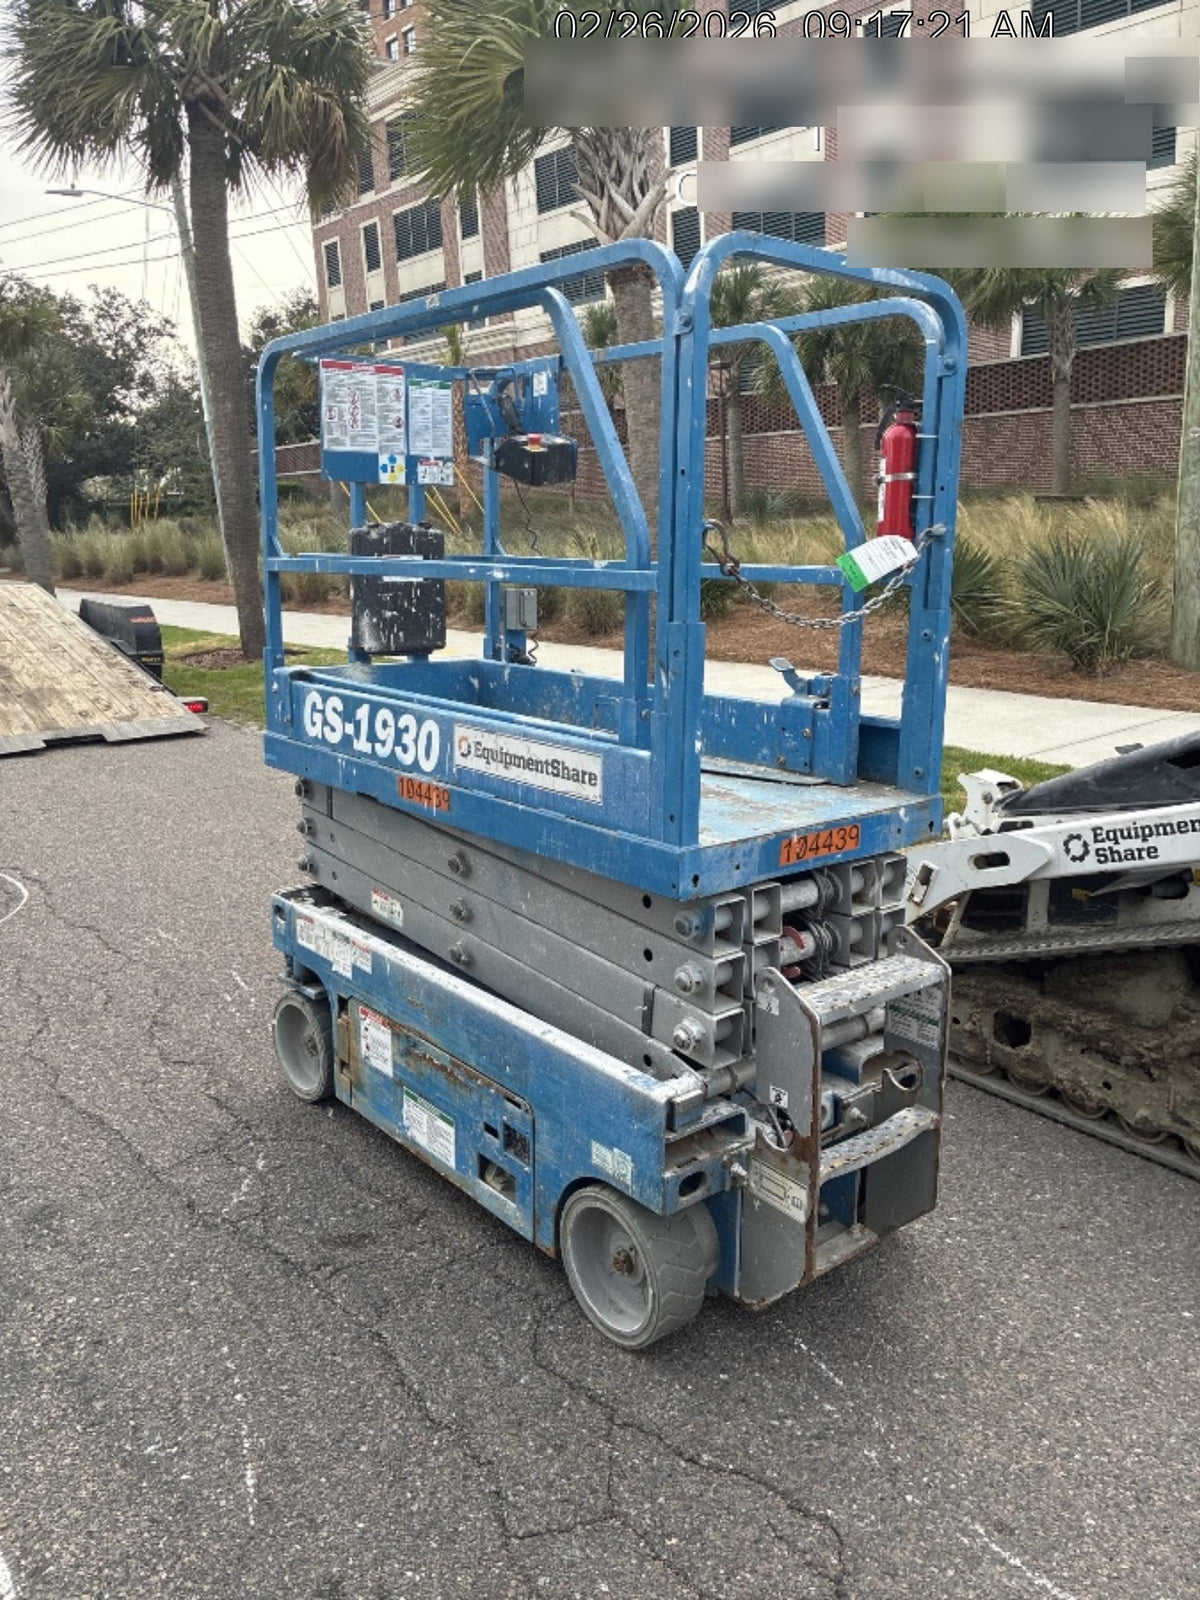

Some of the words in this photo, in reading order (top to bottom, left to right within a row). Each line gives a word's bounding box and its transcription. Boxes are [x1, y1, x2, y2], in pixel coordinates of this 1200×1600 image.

[303, 691, 440, 772] GS-1930
[474, 740, 598, 787] EquipmentShare
[400, 776, 449, 808] 104439
[784, 824, 859, 862] 104439
[1095, 845, 1160, 864] Share
